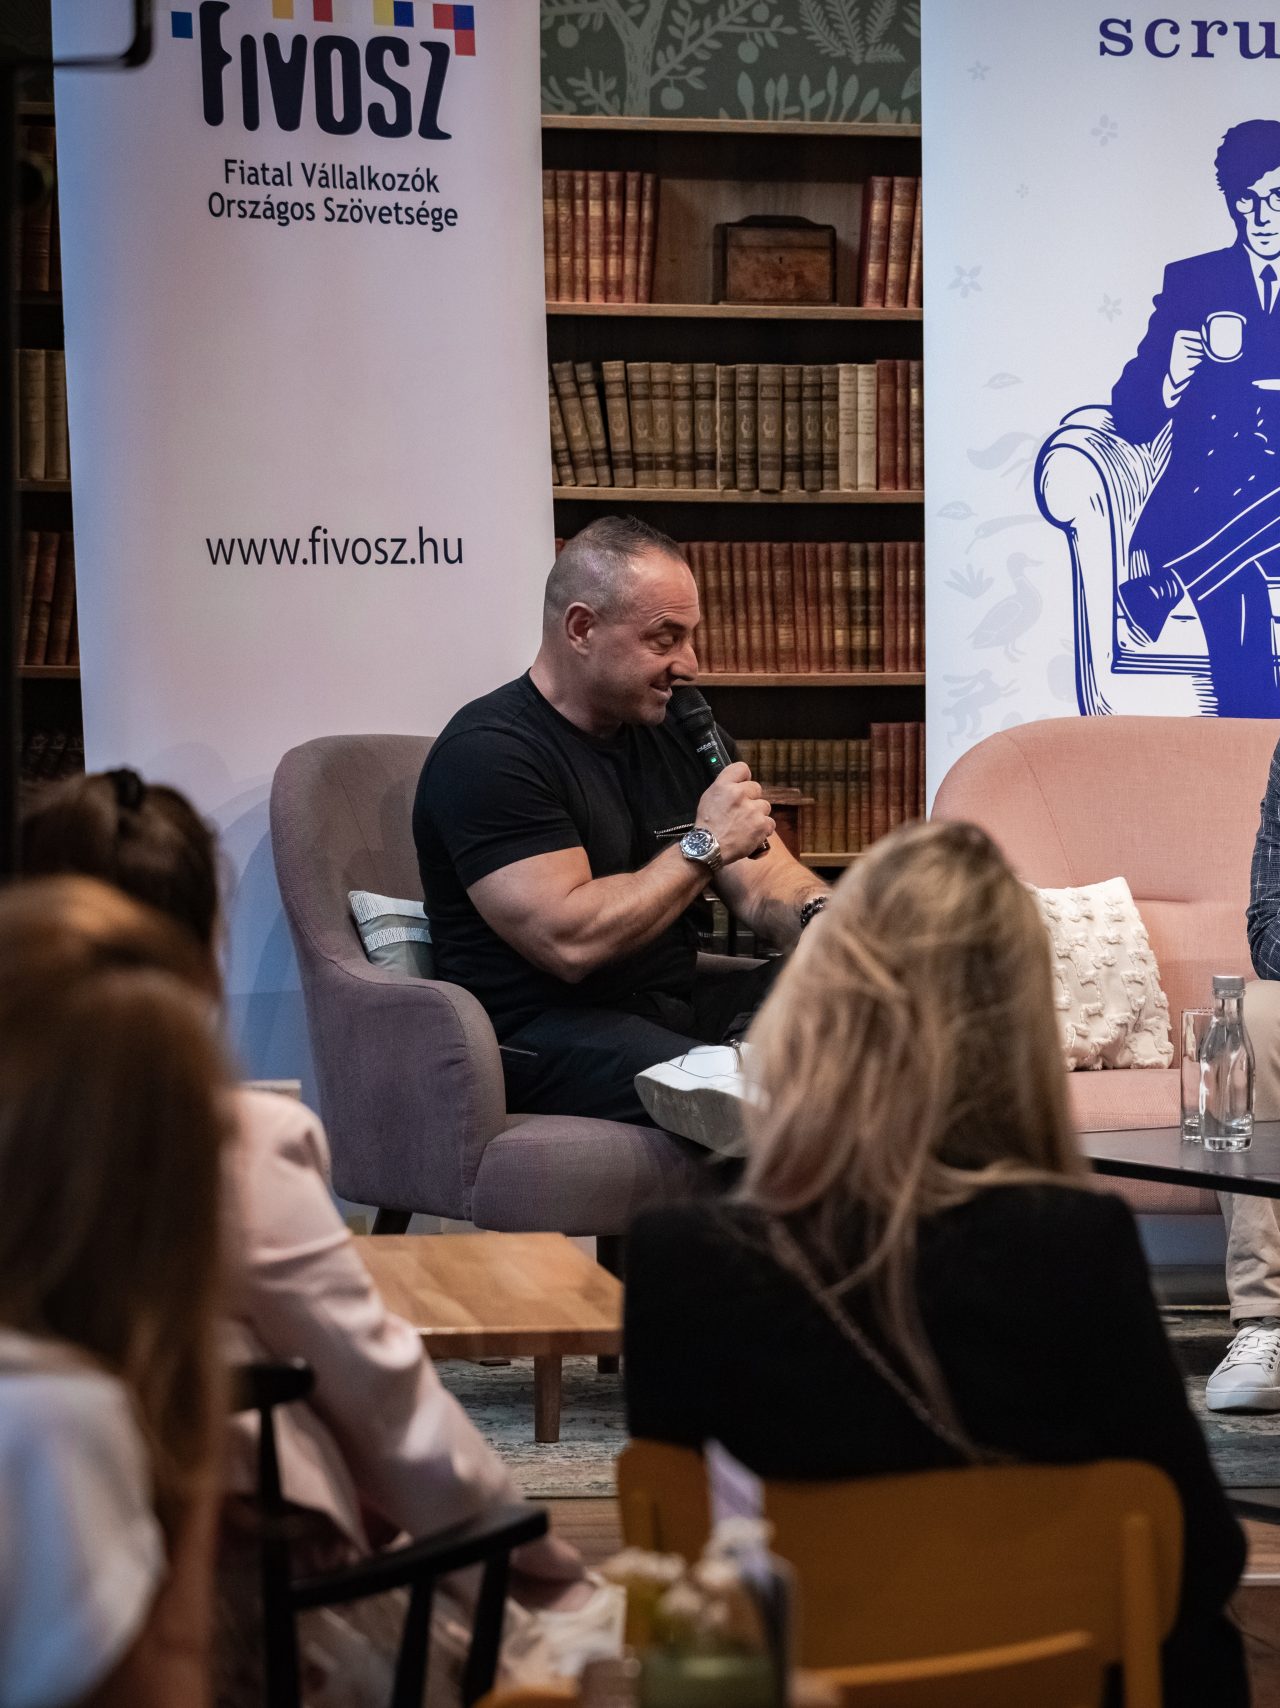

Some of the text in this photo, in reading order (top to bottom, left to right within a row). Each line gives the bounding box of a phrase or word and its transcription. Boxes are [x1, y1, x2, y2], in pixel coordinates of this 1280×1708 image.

[224, 159, 440, 193] Fiatal Vállalkozók
[208, 192, 458, 232] Országos Szövetsége
[205, 525, 463, 566] www.fivosz.hu
